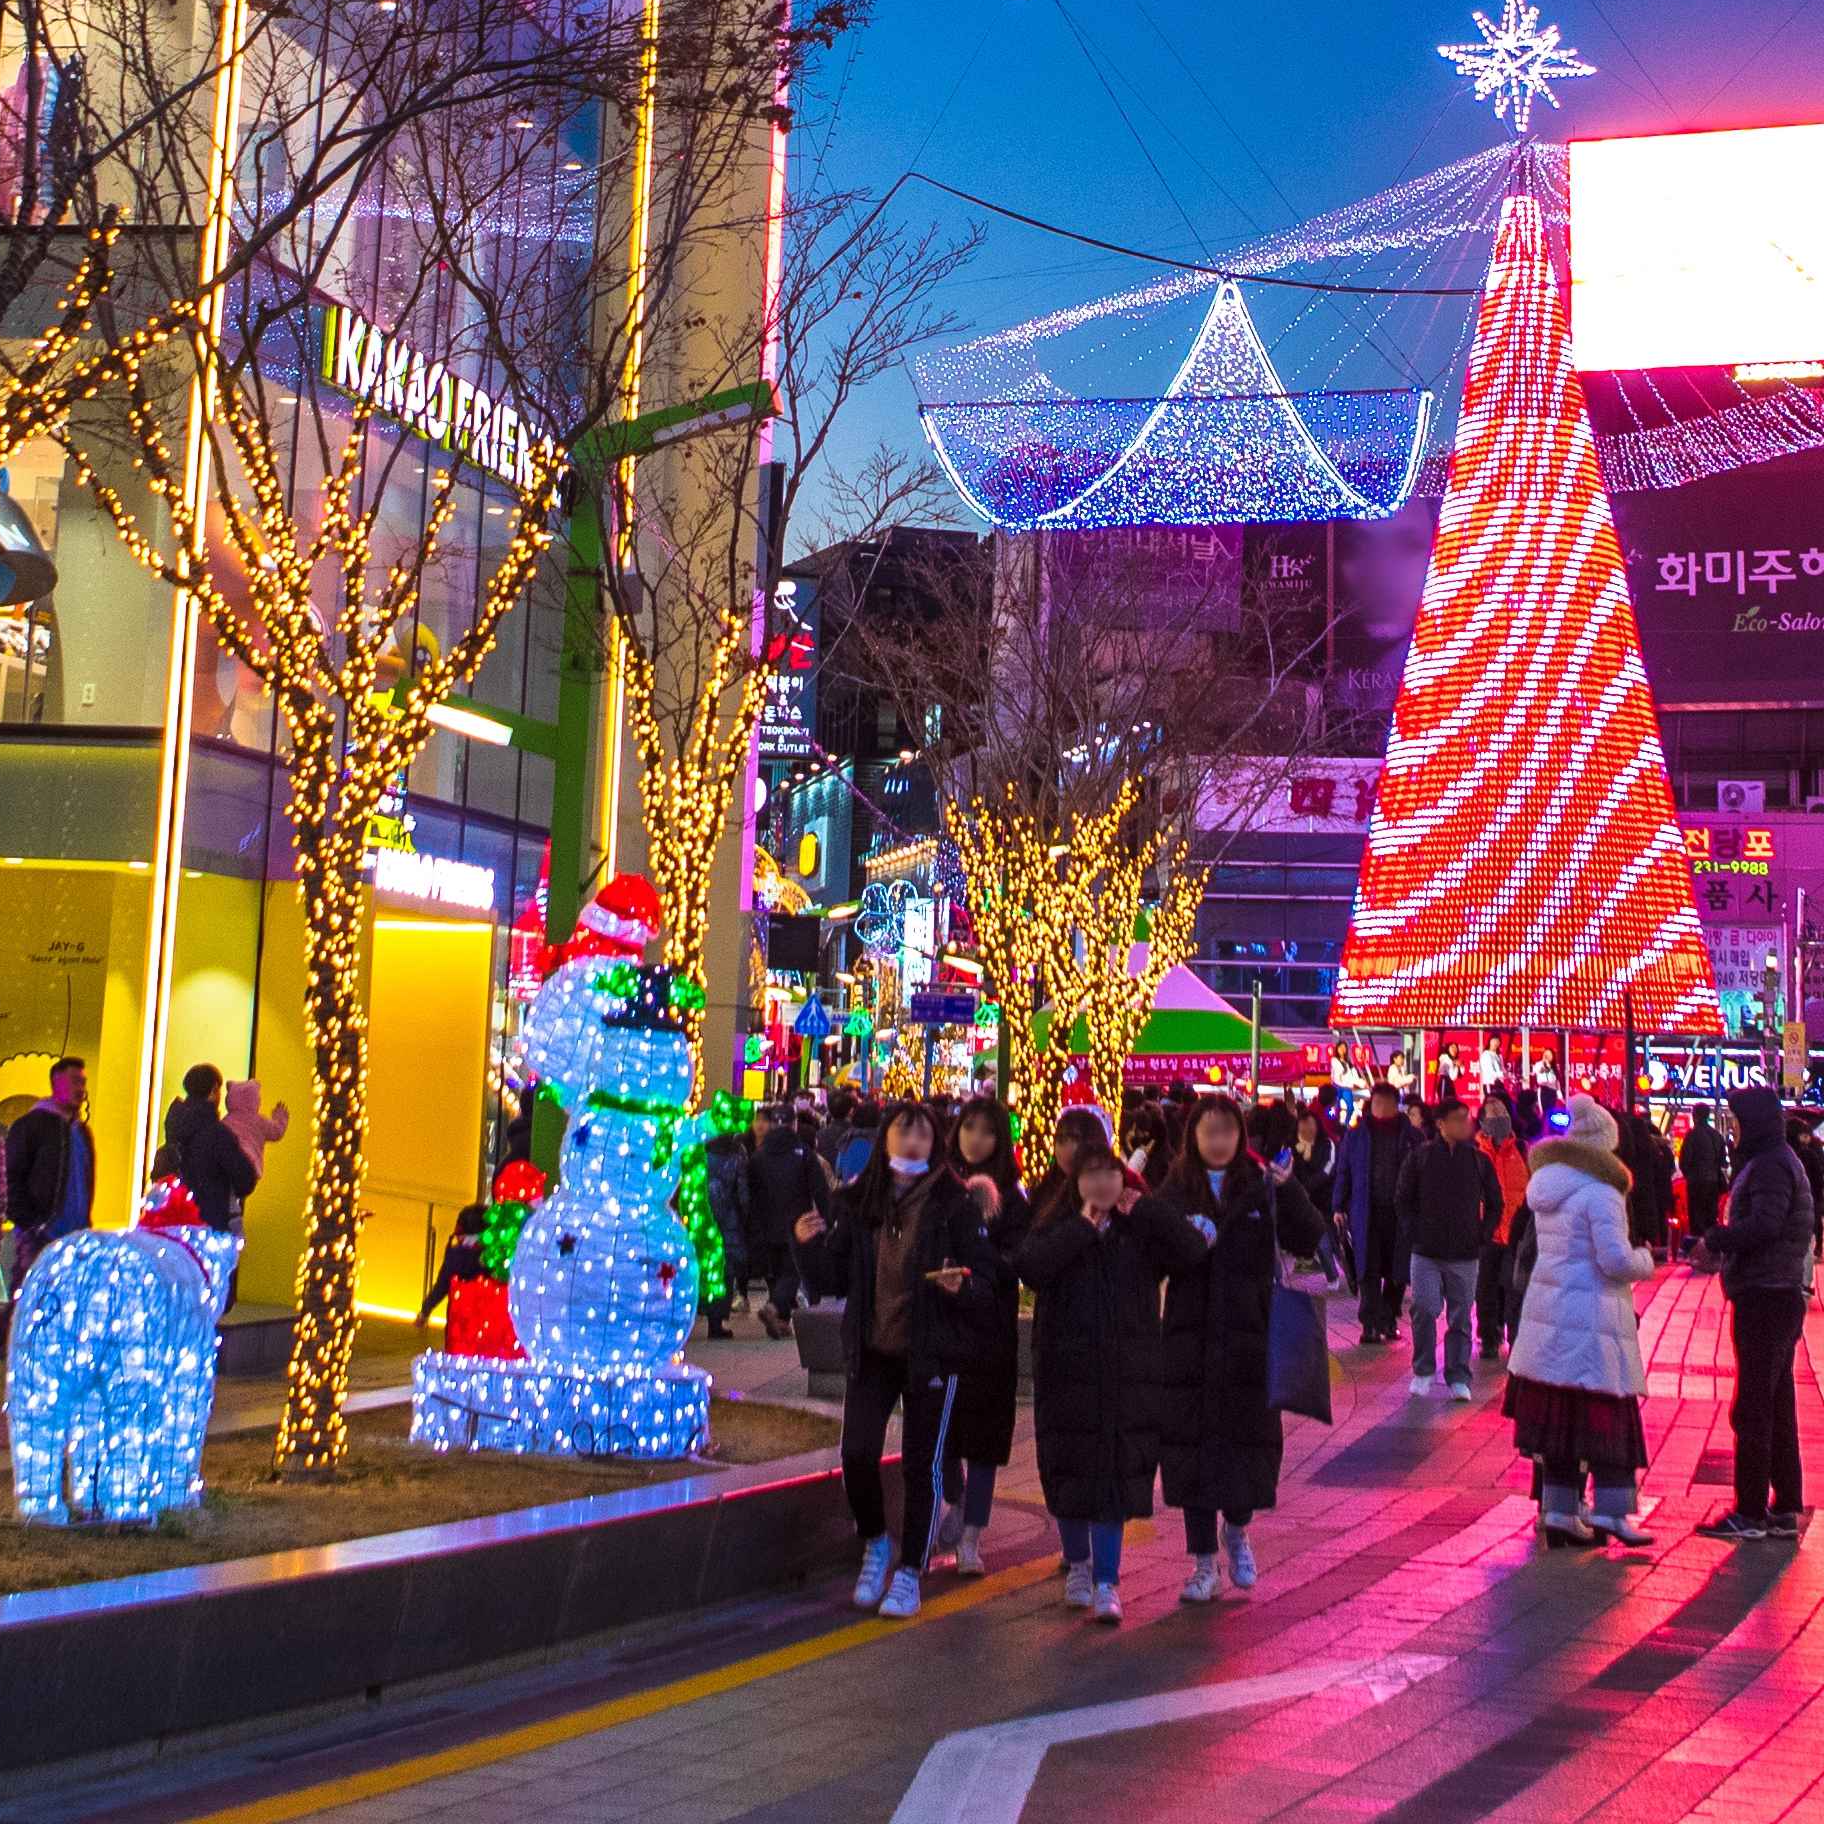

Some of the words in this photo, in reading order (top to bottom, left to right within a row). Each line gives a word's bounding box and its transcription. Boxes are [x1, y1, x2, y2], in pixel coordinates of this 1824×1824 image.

[337, 307, 448, 445] KAKAO
[1685, 828, 1773, 858] 전당포
[1694, 861, 1769, 875] 231-9988
